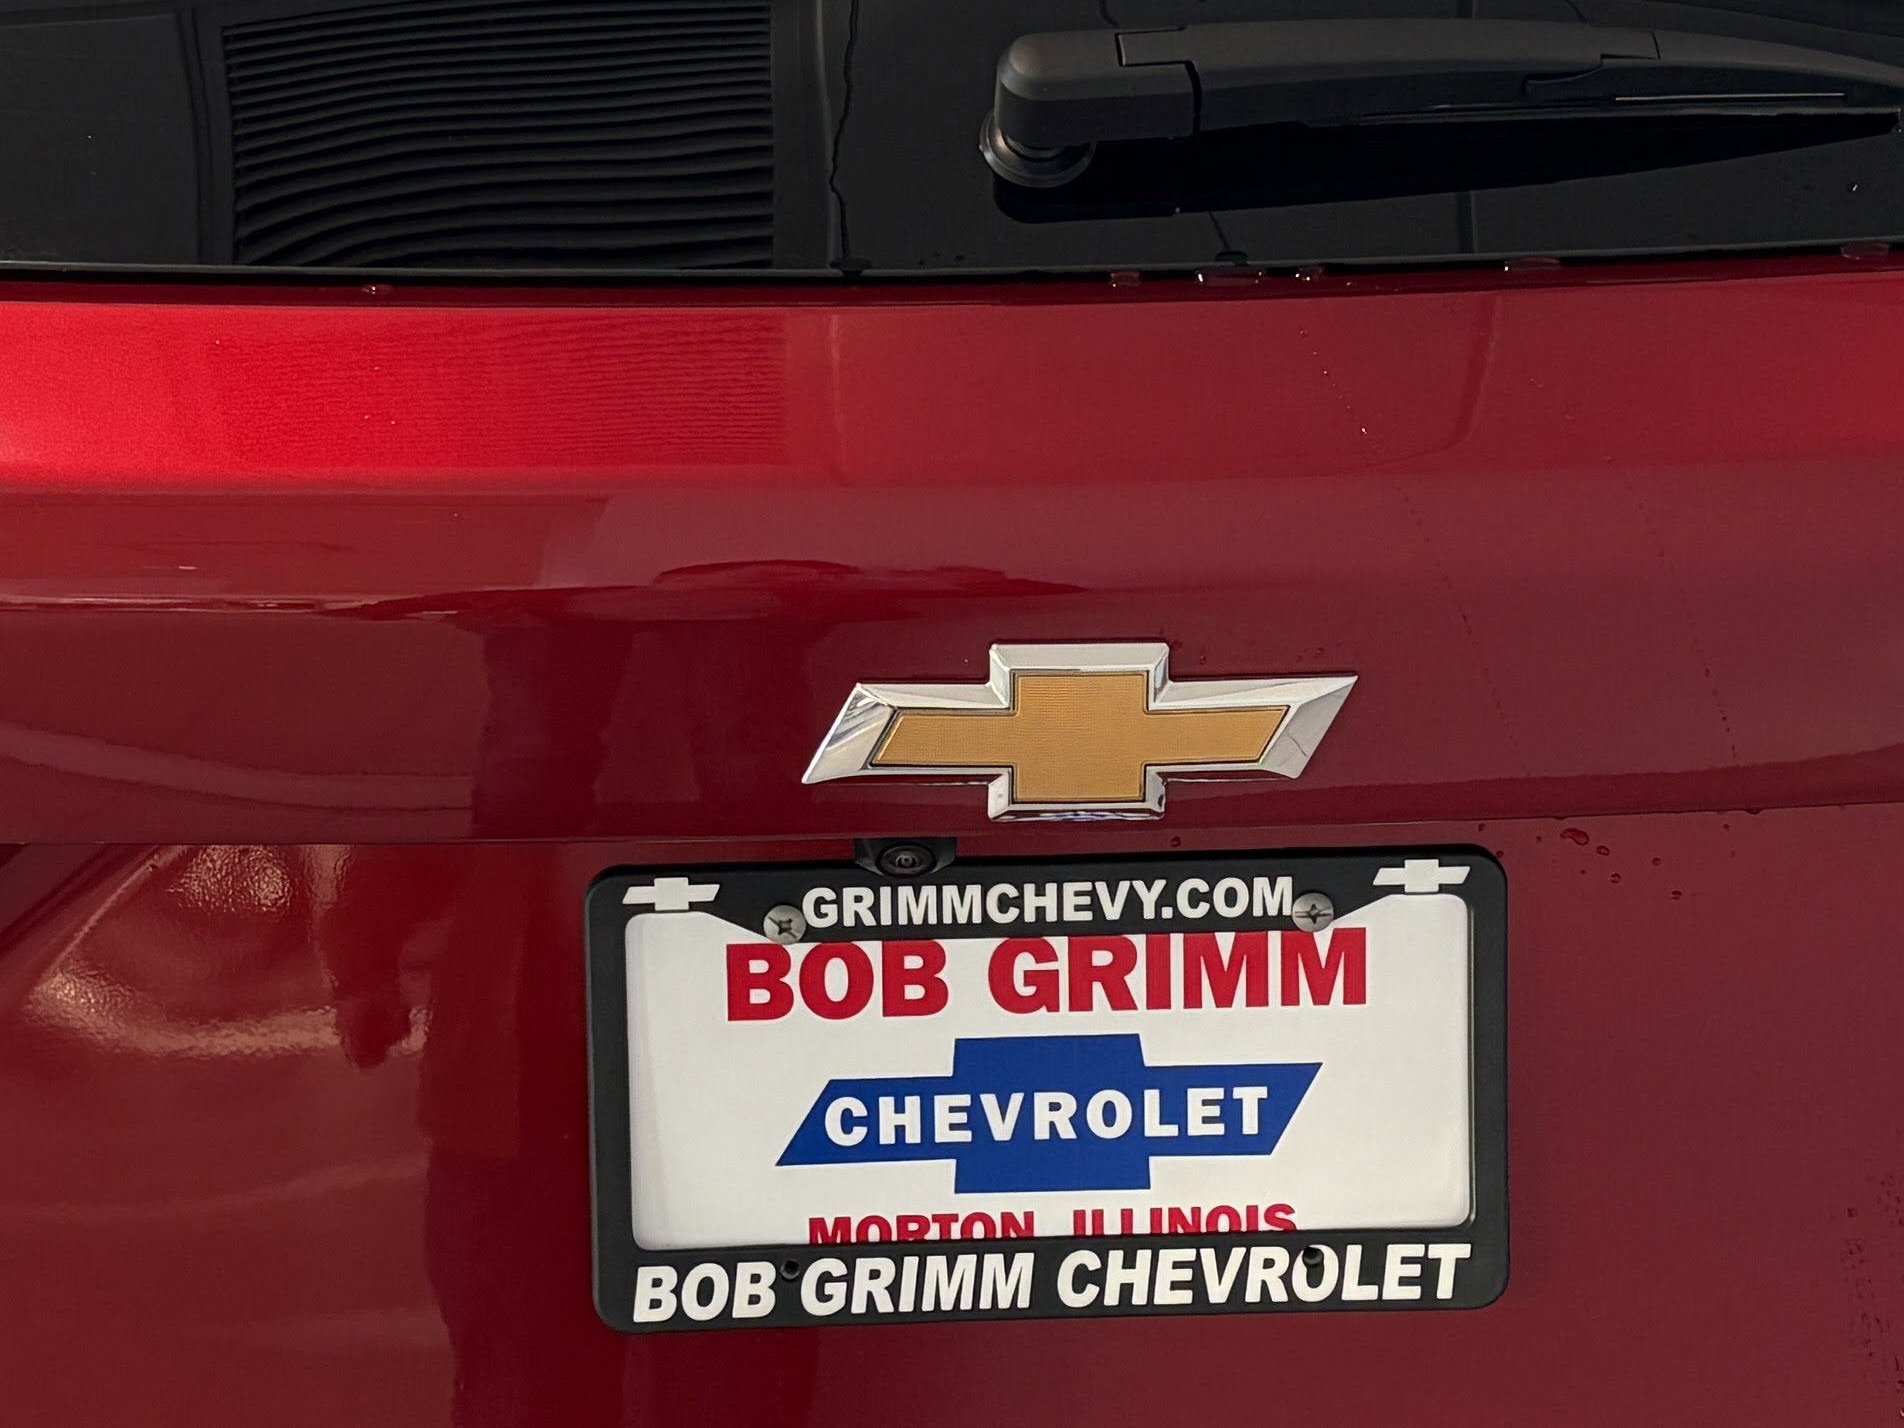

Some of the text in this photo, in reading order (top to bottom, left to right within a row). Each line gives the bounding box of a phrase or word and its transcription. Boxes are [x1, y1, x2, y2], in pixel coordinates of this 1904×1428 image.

[801, 876, 1294, 927] GRIMMCHEVY.COM
[726, 927, 1367, 1021] BOB GRIMM
[824, 1085, 1269, 1147] CHEVROLET
[633, 1243, 1472, 1323] BOB GRIMM CHEVROLET
